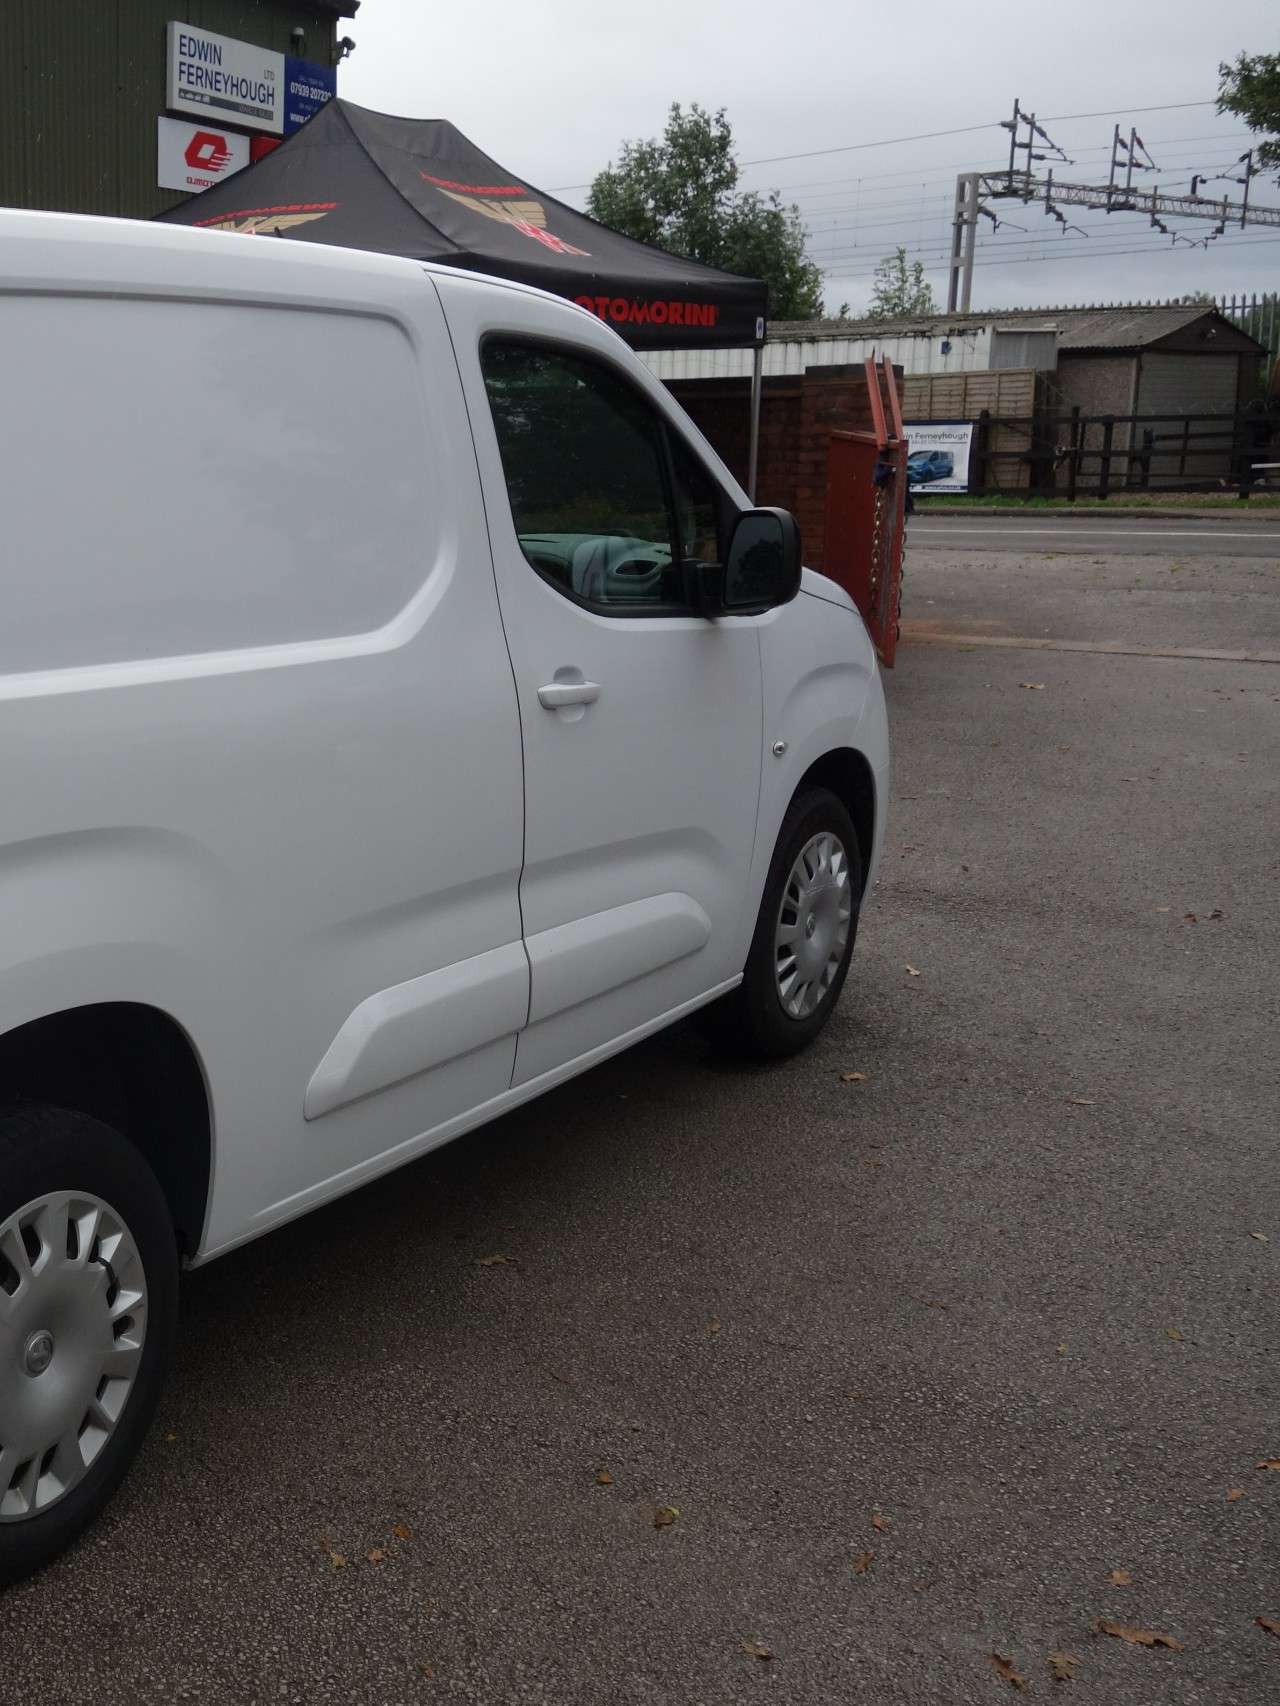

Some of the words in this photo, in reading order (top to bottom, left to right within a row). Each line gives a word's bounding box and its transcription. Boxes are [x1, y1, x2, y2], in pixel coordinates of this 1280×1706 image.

[179, 34, 222, 66] EDWIN
[178, 61, 275, 106] FERNEYHOUGH
[263, 69, 275, 80] LTD
[575, 295, 717, 326] OTOMORINI
